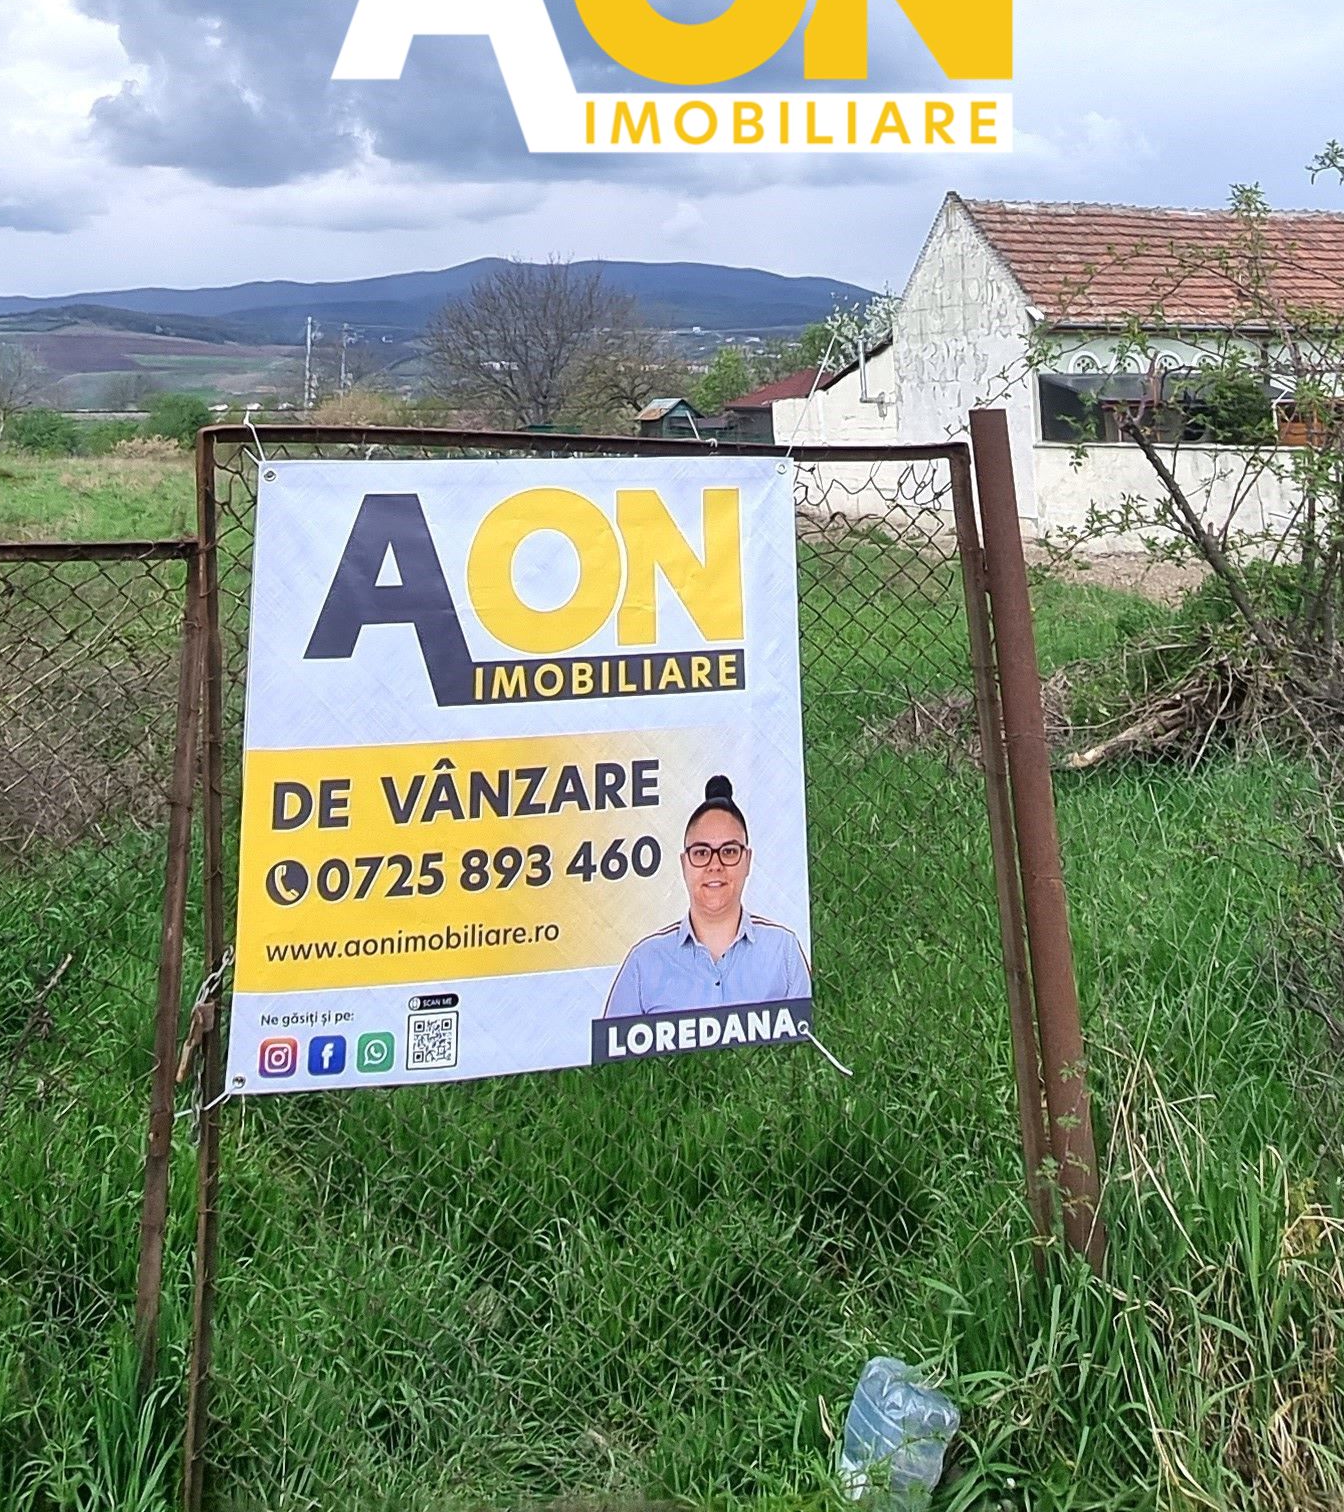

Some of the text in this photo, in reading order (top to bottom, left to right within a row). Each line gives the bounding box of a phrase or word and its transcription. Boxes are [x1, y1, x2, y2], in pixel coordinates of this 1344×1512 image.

[304, 488, 745, 660] AON
[473, 655, 739, 701] IMOBILIARE
[271, 758, 662, 831] DE VÂNZARE
[317, 836, 662, 903] 0725 893 460
[265, 922, 560, 963] www.aonimobiliare.ro
[260, 1013, 279, 1026] Ne
[335, 1012, 355, 1026] pe:
[607, 1007, 798, 1058] LOREDANA
